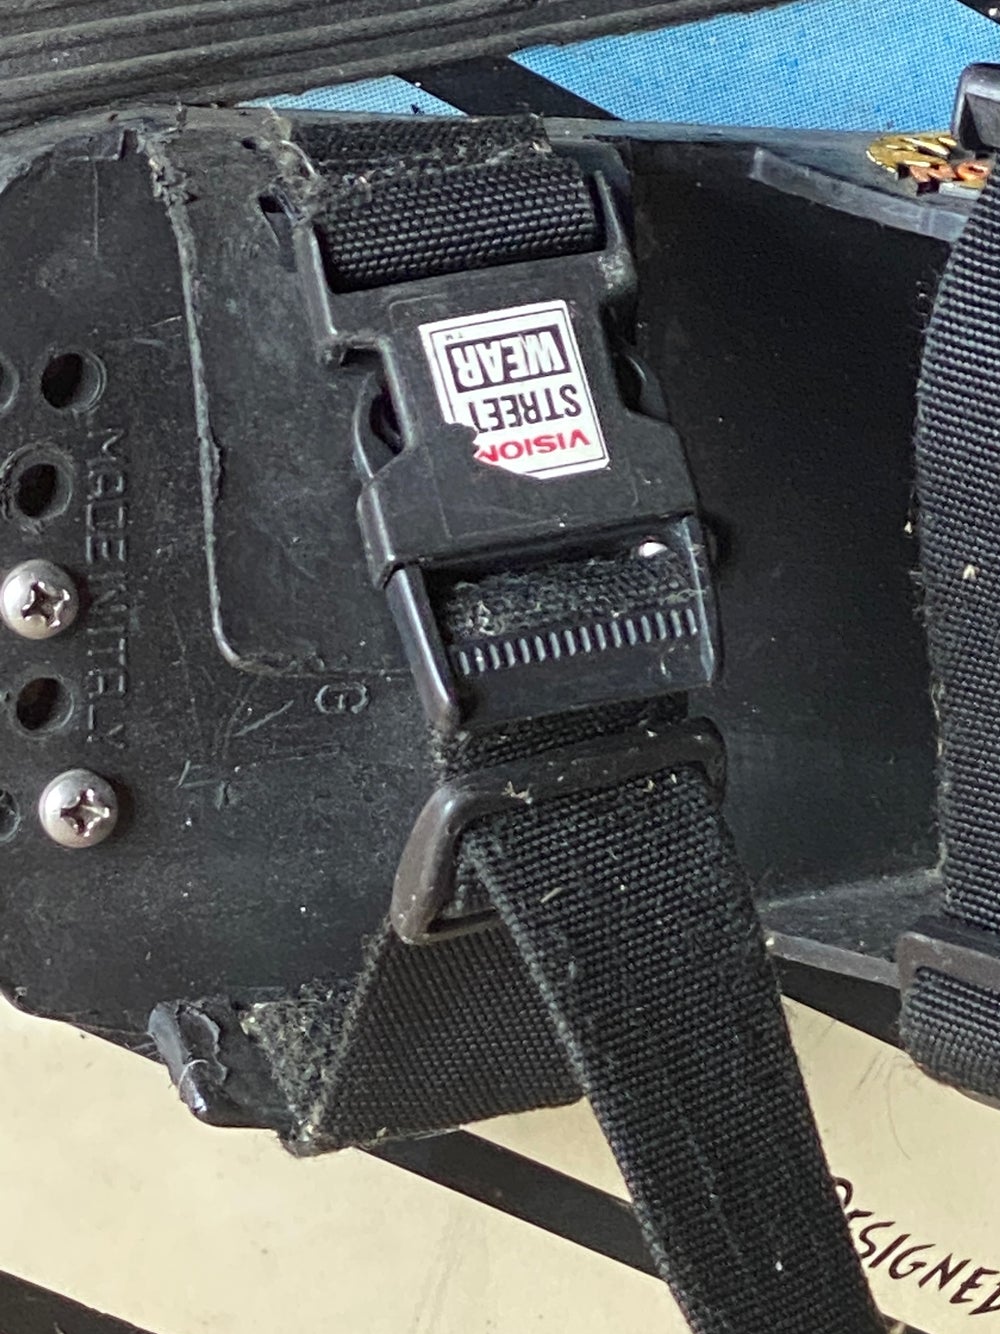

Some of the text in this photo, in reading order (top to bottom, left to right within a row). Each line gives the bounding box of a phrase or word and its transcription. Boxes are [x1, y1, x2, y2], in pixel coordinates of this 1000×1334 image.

[450, 330, 566, 389] WEAR
[468, 384, 582, 434] STREET
[476, 429, 591, 463] VISION
